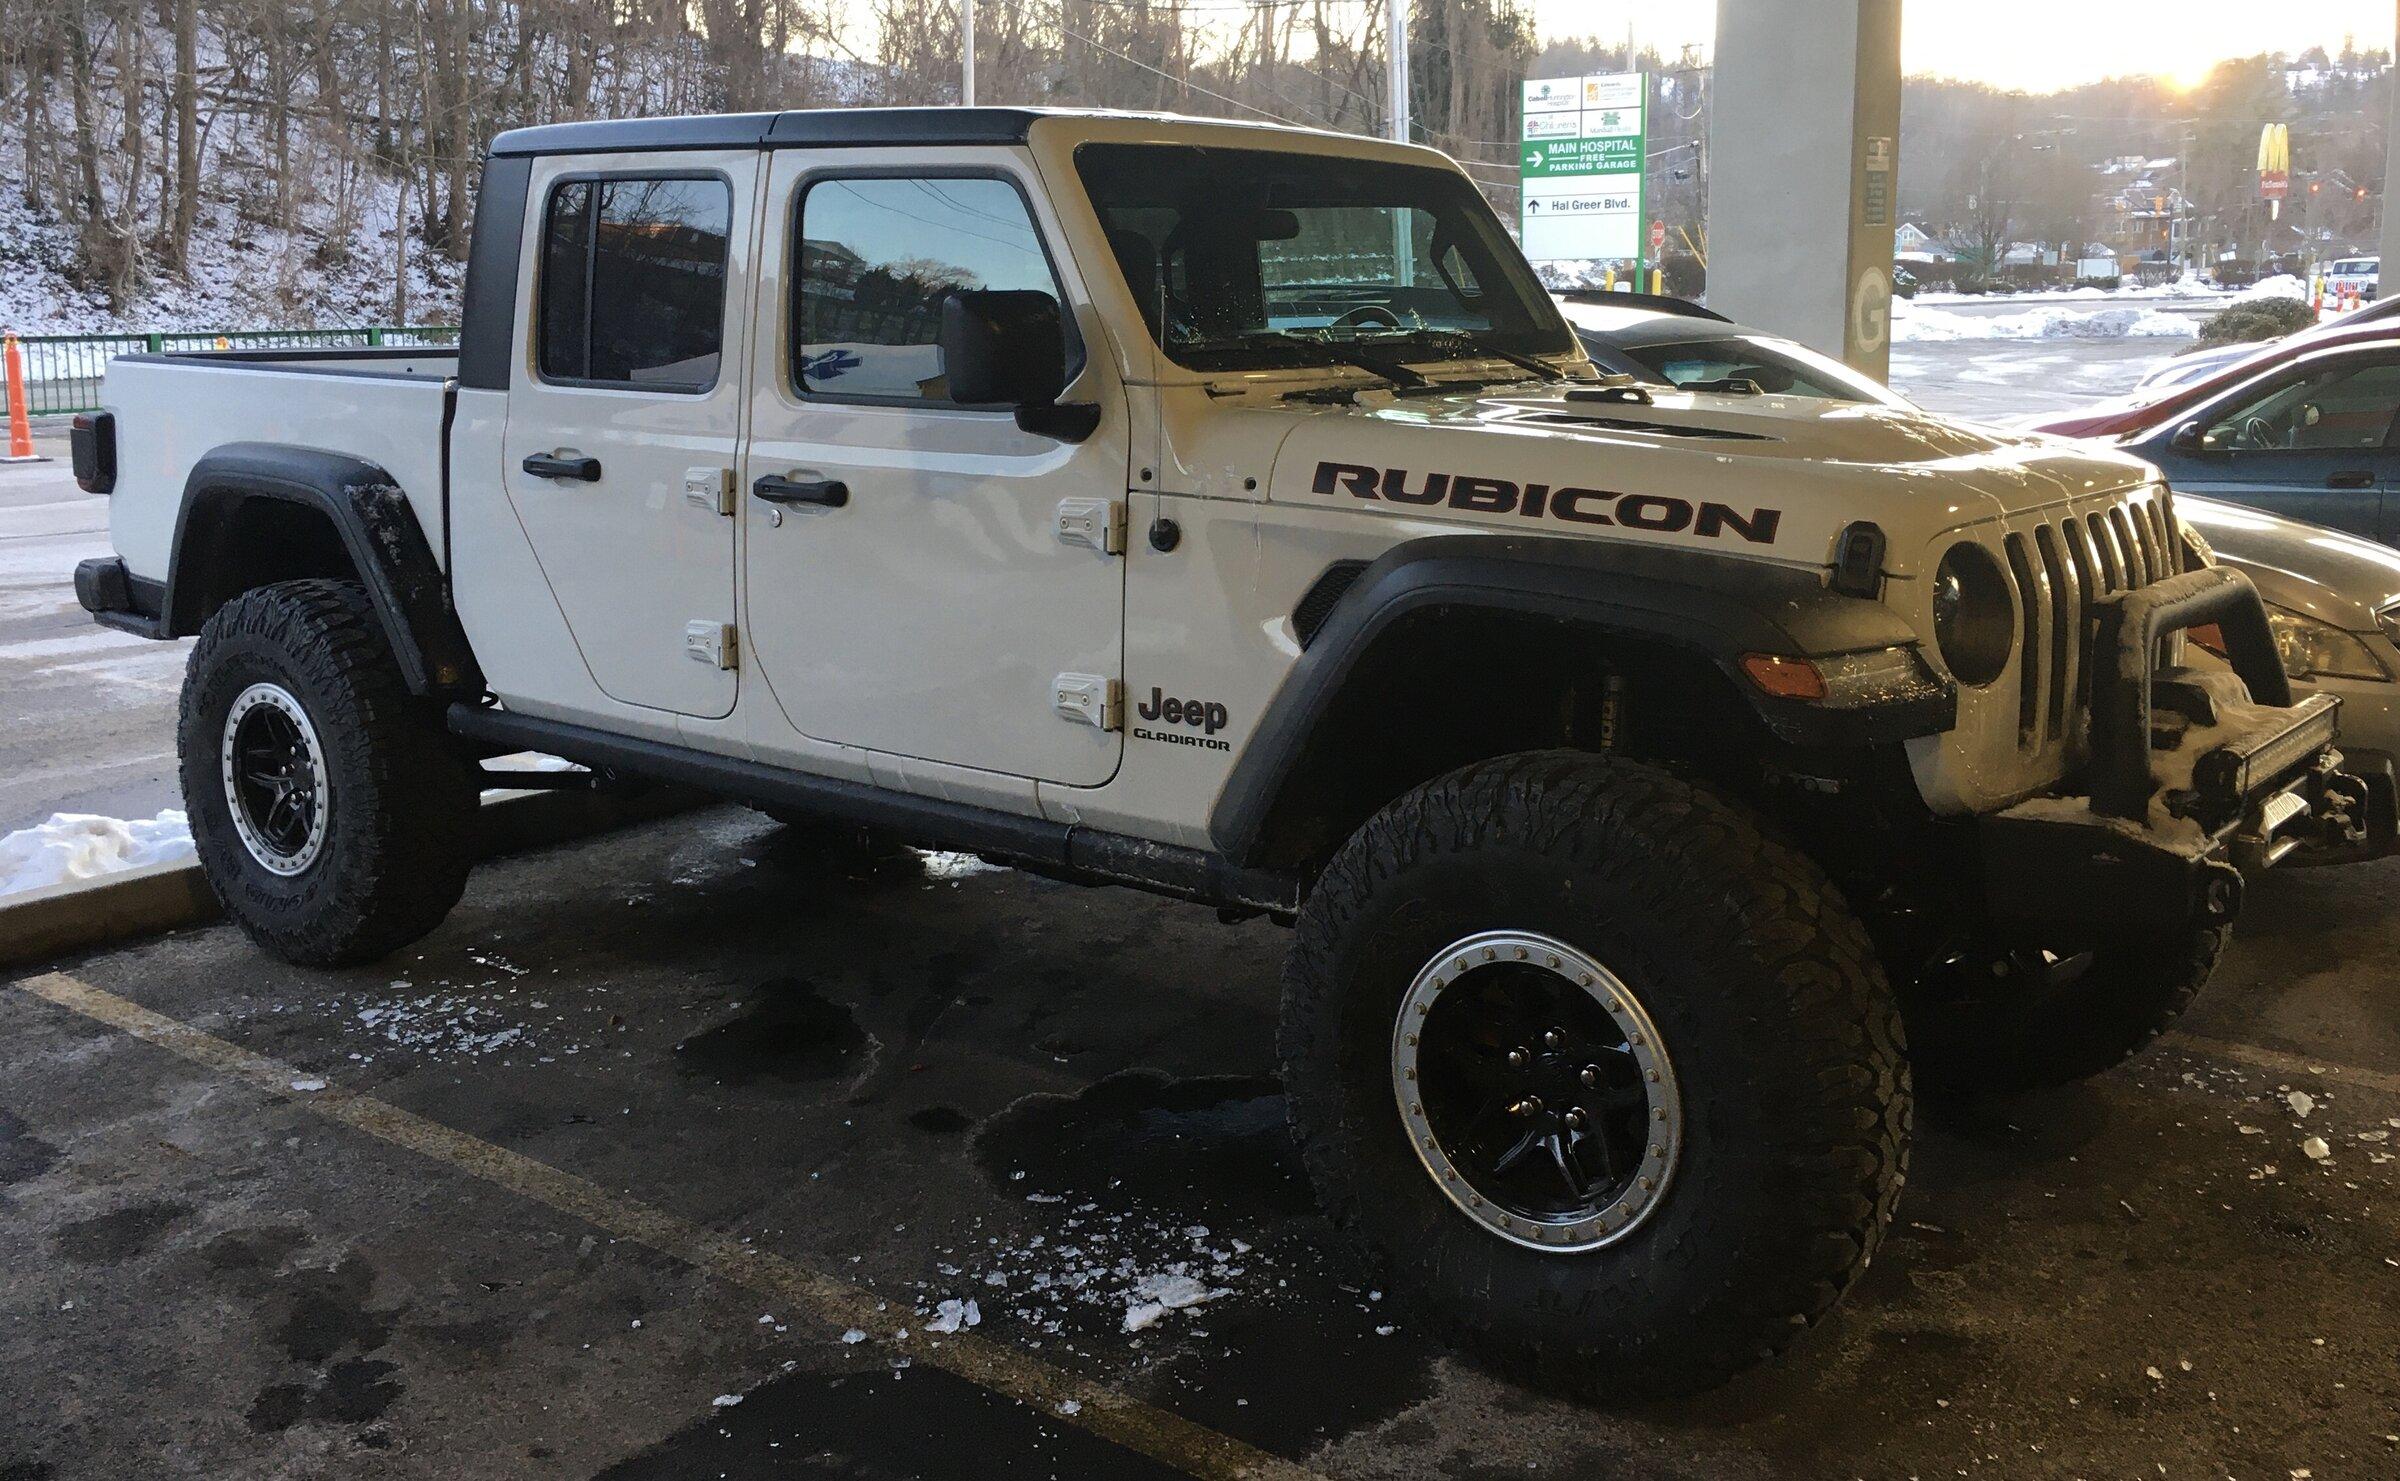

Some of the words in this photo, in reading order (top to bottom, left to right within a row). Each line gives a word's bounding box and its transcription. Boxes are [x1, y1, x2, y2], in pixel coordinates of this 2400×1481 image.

[1549, 143, 1577, 155] MAIN
[1580, 139, 1637, 153] HOSPITAL
[1549, 162, 1593, 172] PARKING
[1596, 160, 1637, 170] GARAGE
[1580, 153, 1605, 162] FREE
[1552, 200, 1569, 211] Hal
[1572, 199, 1602, 211] Greer
[1604, 198, 1631, 209] Blvd.
[1855, 266, 1889, 353] G
[1312, 461, 1781, 544] RUBICON
[1138, 686, 1228, 735] Jeep
[1133, 728, 1231, 752] GLADIATOR
